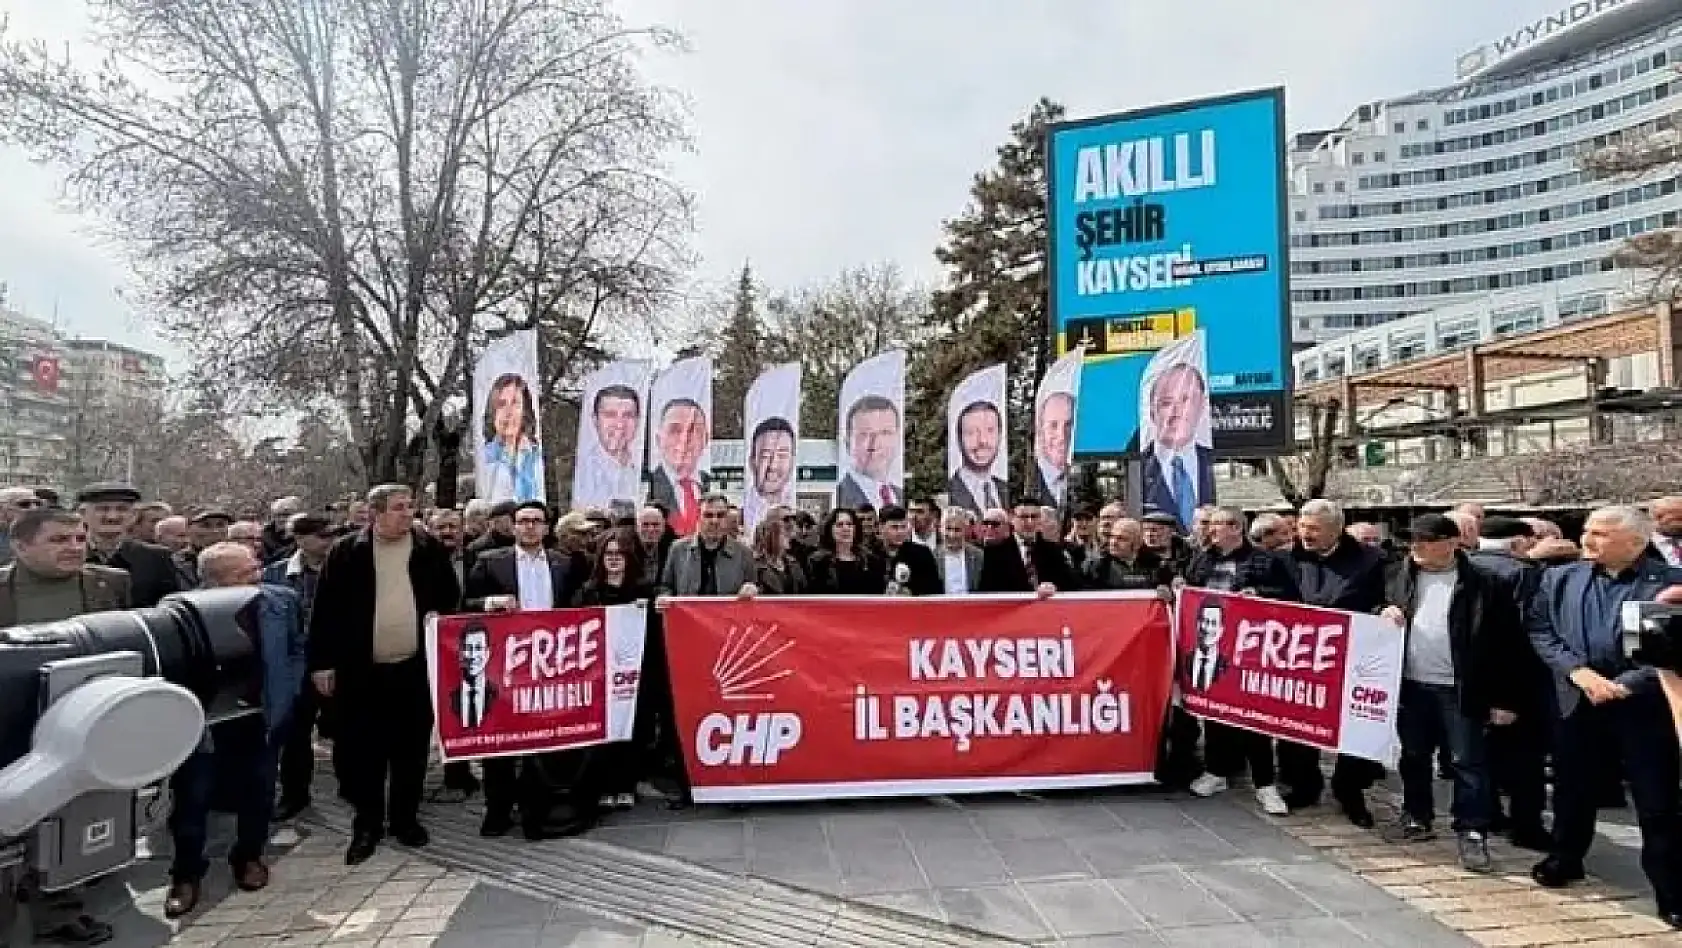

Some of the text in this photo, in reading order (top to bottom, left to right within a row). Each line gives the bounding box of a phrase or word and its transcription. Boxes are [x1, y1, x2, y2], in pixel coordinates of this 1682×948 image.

[1074, 129, 1216, 203] AKILLI
[1076, 198, 1166, 261] ŞEHİR
[502, 618, 602, 688] FREE
[909, 626, 1075, 679] KAYSERİ
[1232, 619, 1343, 672] FREE
[854, 680, 1132, 752] İL BAŞKANLIĞI
[1351, 686, 1389, 706] CHP
[696, 711, 801, 767] CHP
